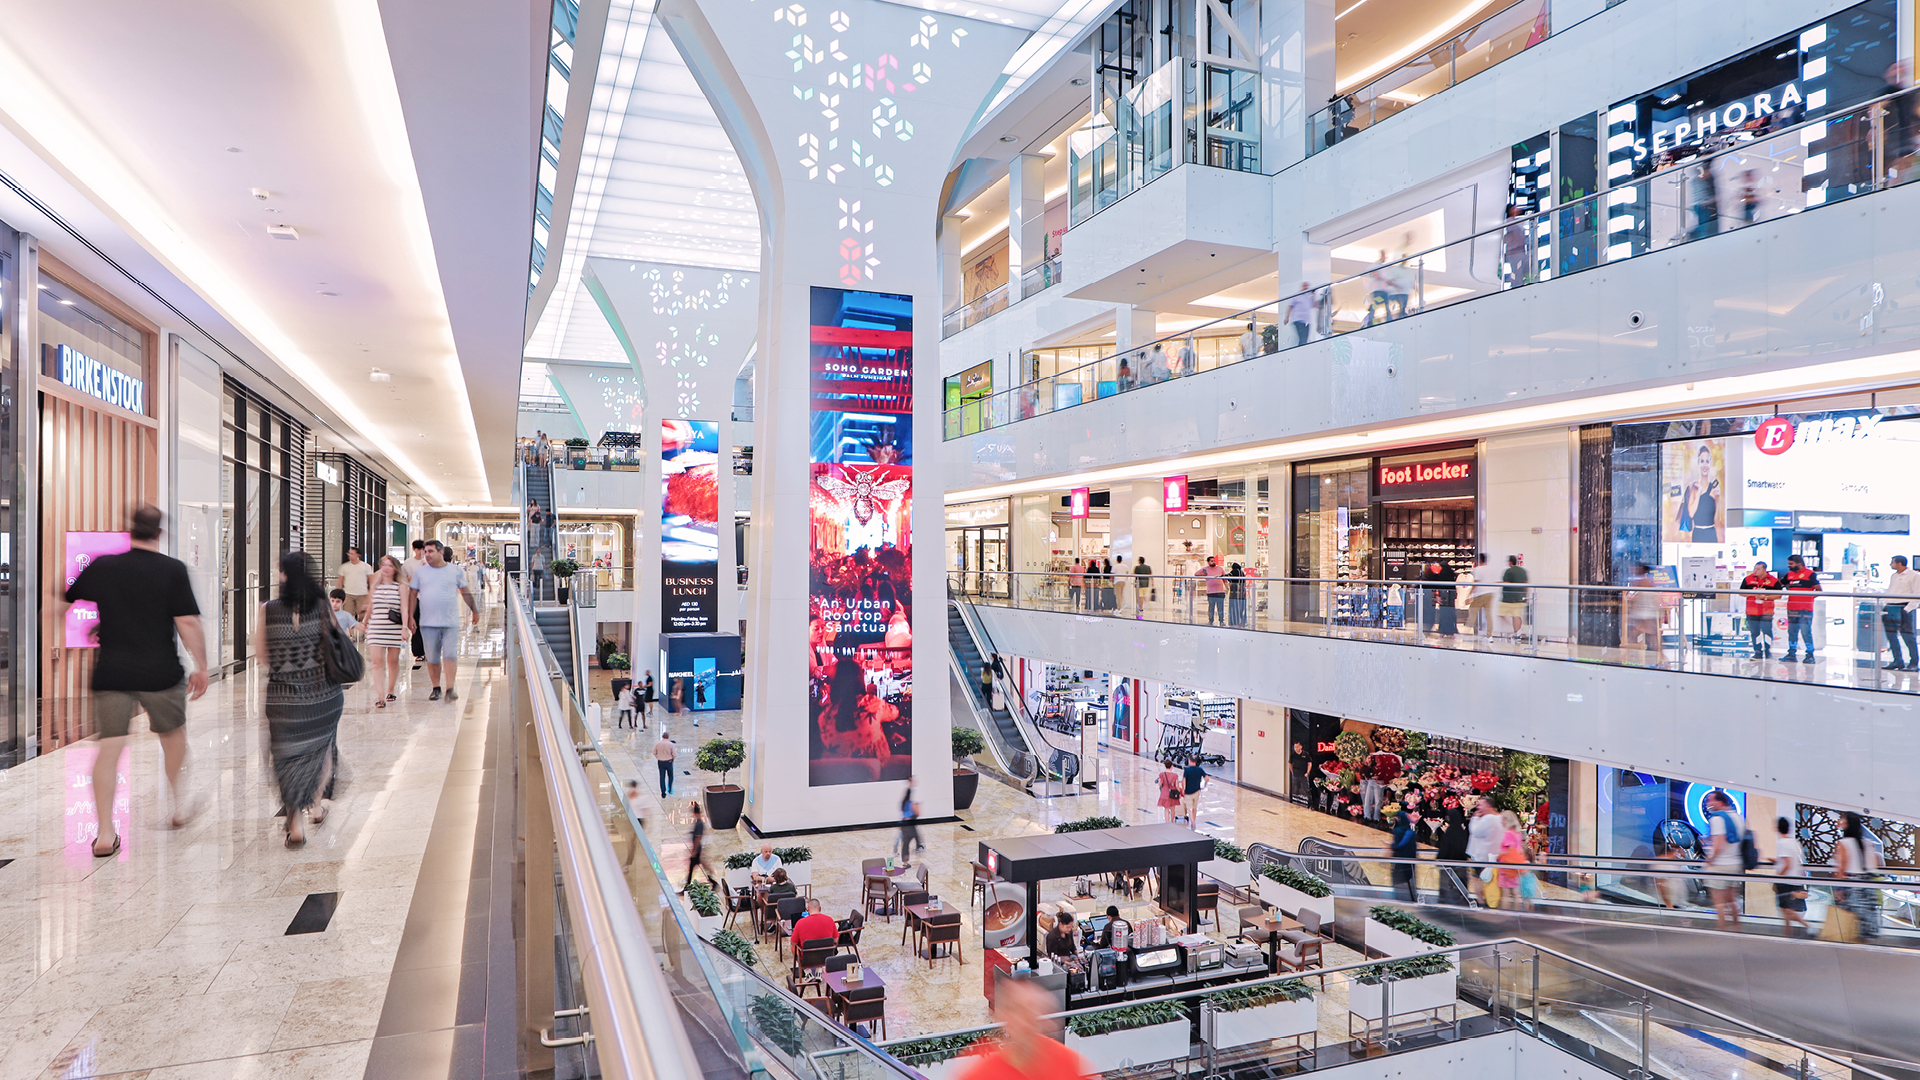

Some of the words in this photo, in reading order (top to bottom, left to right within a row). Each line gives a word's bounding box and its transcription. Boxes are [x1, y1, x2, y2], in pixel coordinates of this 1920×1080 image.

[1633, 83, 1802, 161] SEPHORA
[824, 362, 858, 374] SOHO
[861, 366, 909, 378] GARDEN
[60, 344, 144, 415] BIRKENSTOCK
[1381, 466, 1413, 485] Foot
[665, 577, 714, 586] BUSINESS
[673, 587, 707, 596] LUNCH
[845, 597, 891, 609] Urban
[823, 609, 883, 623] Rooftop
